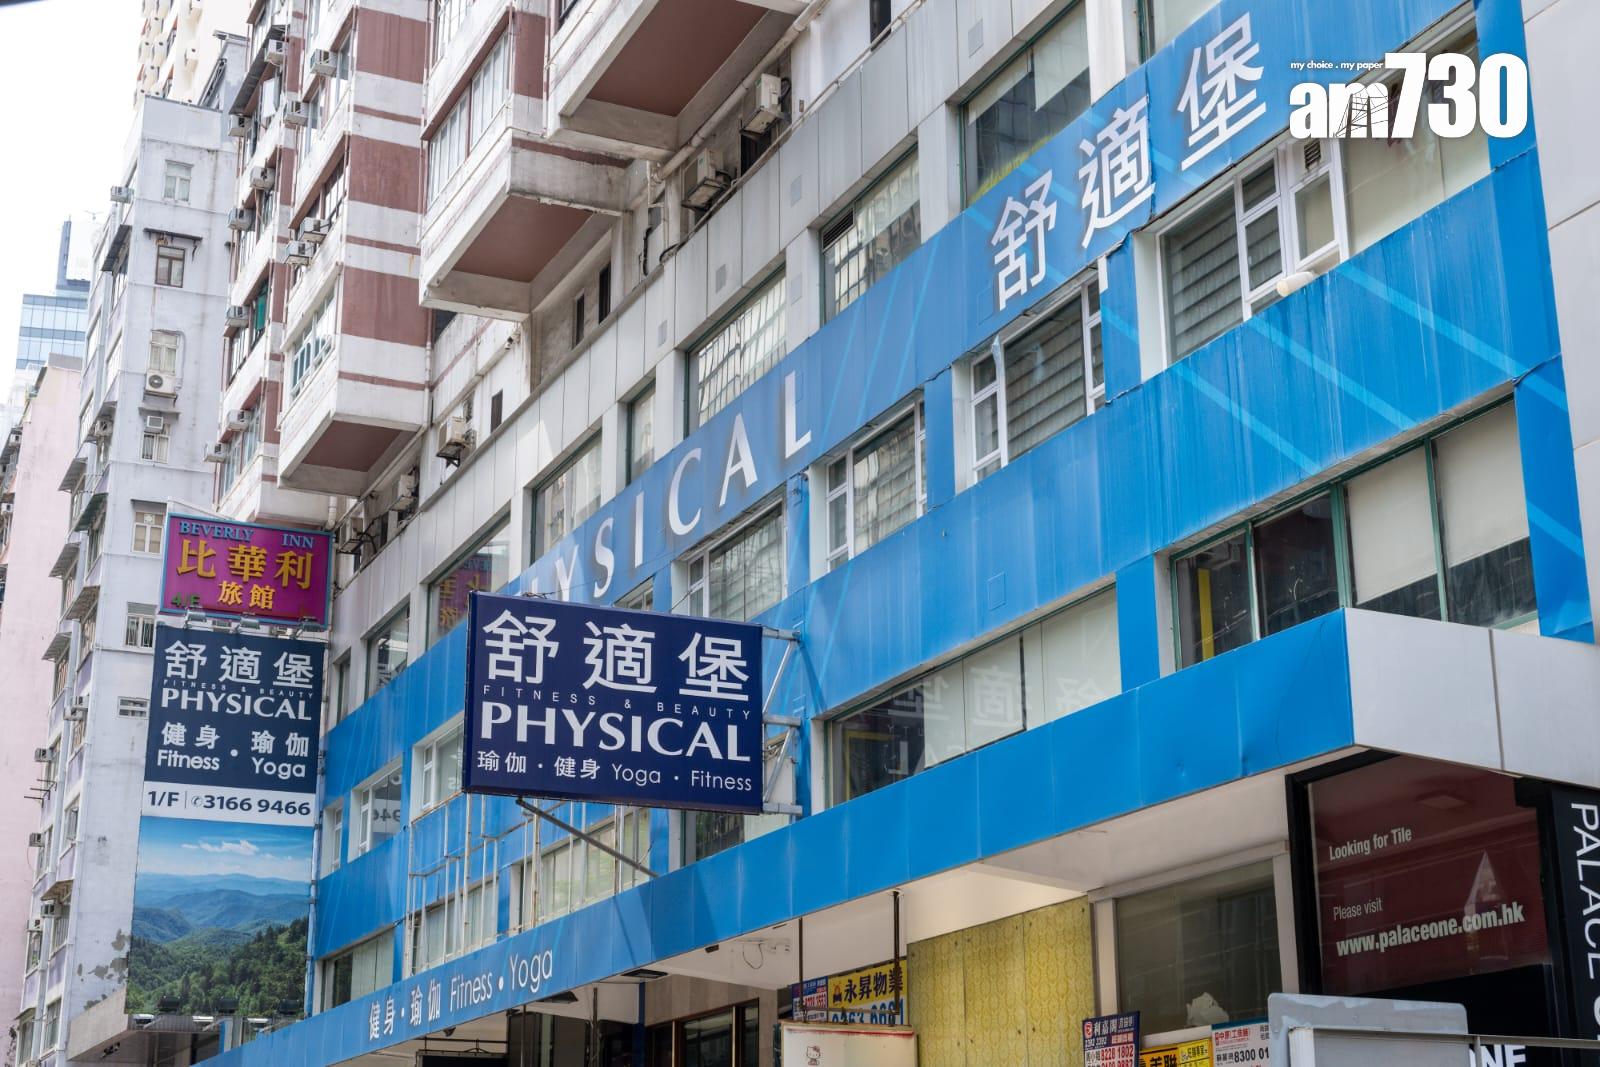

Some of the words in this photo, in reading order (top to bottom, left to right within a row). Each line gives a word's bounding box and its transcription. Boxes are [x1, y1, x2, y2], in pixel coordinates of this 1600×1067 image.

[990, 12, 1266, 311] 舒適堡
[179, 521, 255, 542] BEVERLY
[282, 534, 314, 549] INN
[177, 540, 314, 590] 比華利
[217, 580, 275, 609] 旅館
[165, 639, 314, 690] 舒適堡
[482, 609, 750, 702] 舒適堡
[160, 687, 312, 721] PHYSICAL
[163, 679, 226, 691] FITNESS
[259, 688, 314, 700] BEAUTY
[483, 684, 596, 706] FITNESS
[624, 699, 632, 710] &
[656, 701, 751, 720] BEAUTY
[161, 721, 220, 750] 健身
[251, 730, 309, 757] 瑜伽
[480, 701, 751, 763] PHYSICAL
[157, 749, 221, 771] Fitness
[251, 757, 306, 779] Yoga
[477, 750, 527, 774] 瑜伽
[553, 756, 600, 780] 健身
[612, 763, 661, 787] Yoga
[691, 771, 752, 792] Fitness
[147, 790, 180, 808] 1/F
[202, 794, 253, 812] 3166
[258, 798, 311, 816] 9466
[1329, 840, 1371, 861] Looking
[1373, 833, 1388, 849] for
[1391, 826, 1413, 845] Tile
[1571, 802, 1600, 979] PALACE
[1333, 903, 1362, 920] Please
[1364, 898, 1383, 914] visit
[1336, 901, 1525, 957] www.palaceone.com.hk
[368, 996, 396, 1040] 健身
[450, 972, 493, 1013] Fitness
[509, 949, 553, 993] Yoga
